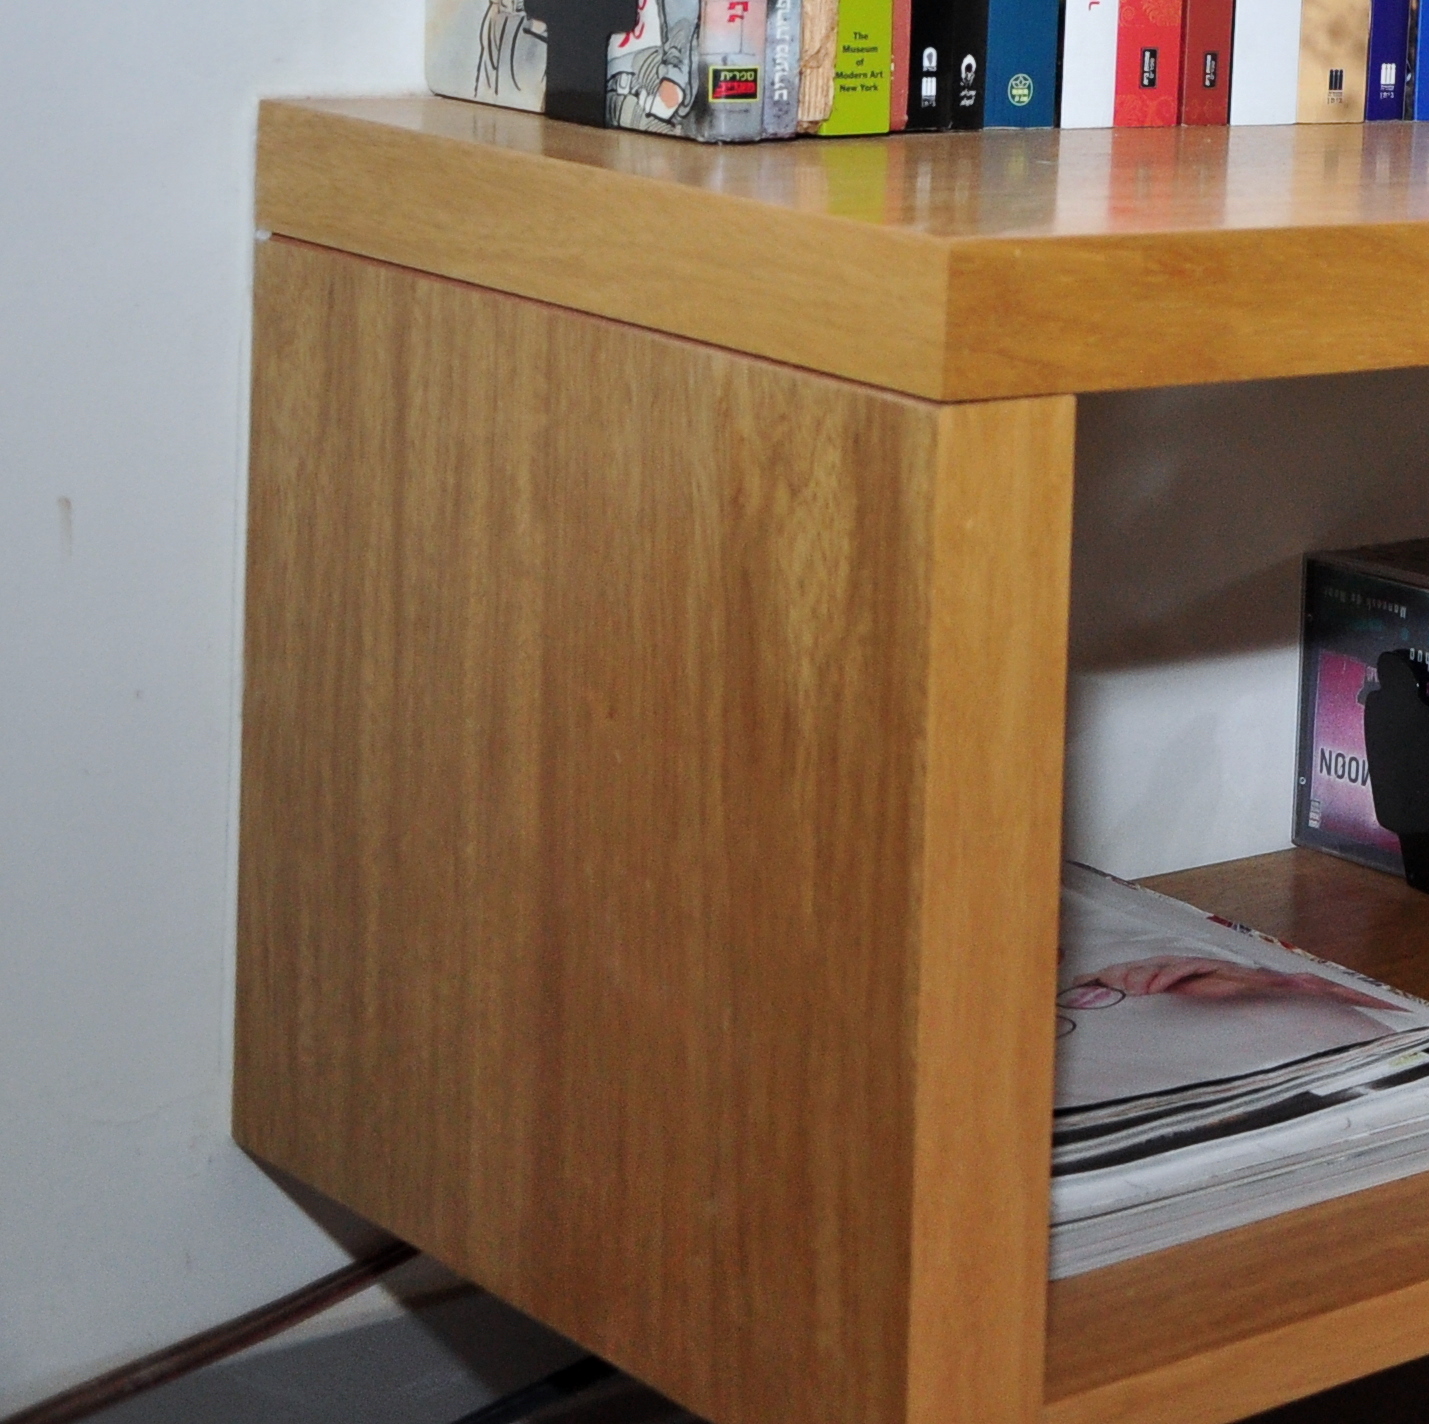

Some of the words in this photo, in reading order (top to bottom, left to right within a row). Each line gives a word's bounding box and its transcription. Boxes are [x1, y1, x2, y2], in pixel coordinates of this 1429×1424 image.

[853, 31, 869, 40] The
[842, 45, 878, 53] Museum
[856, 58, 864, 66] of
[773, 44, 790, 101] מעריב
[835, 71, 868, 79] Modern
[840, 84, 857, 92] New
[860, 83, 878, 91] York
